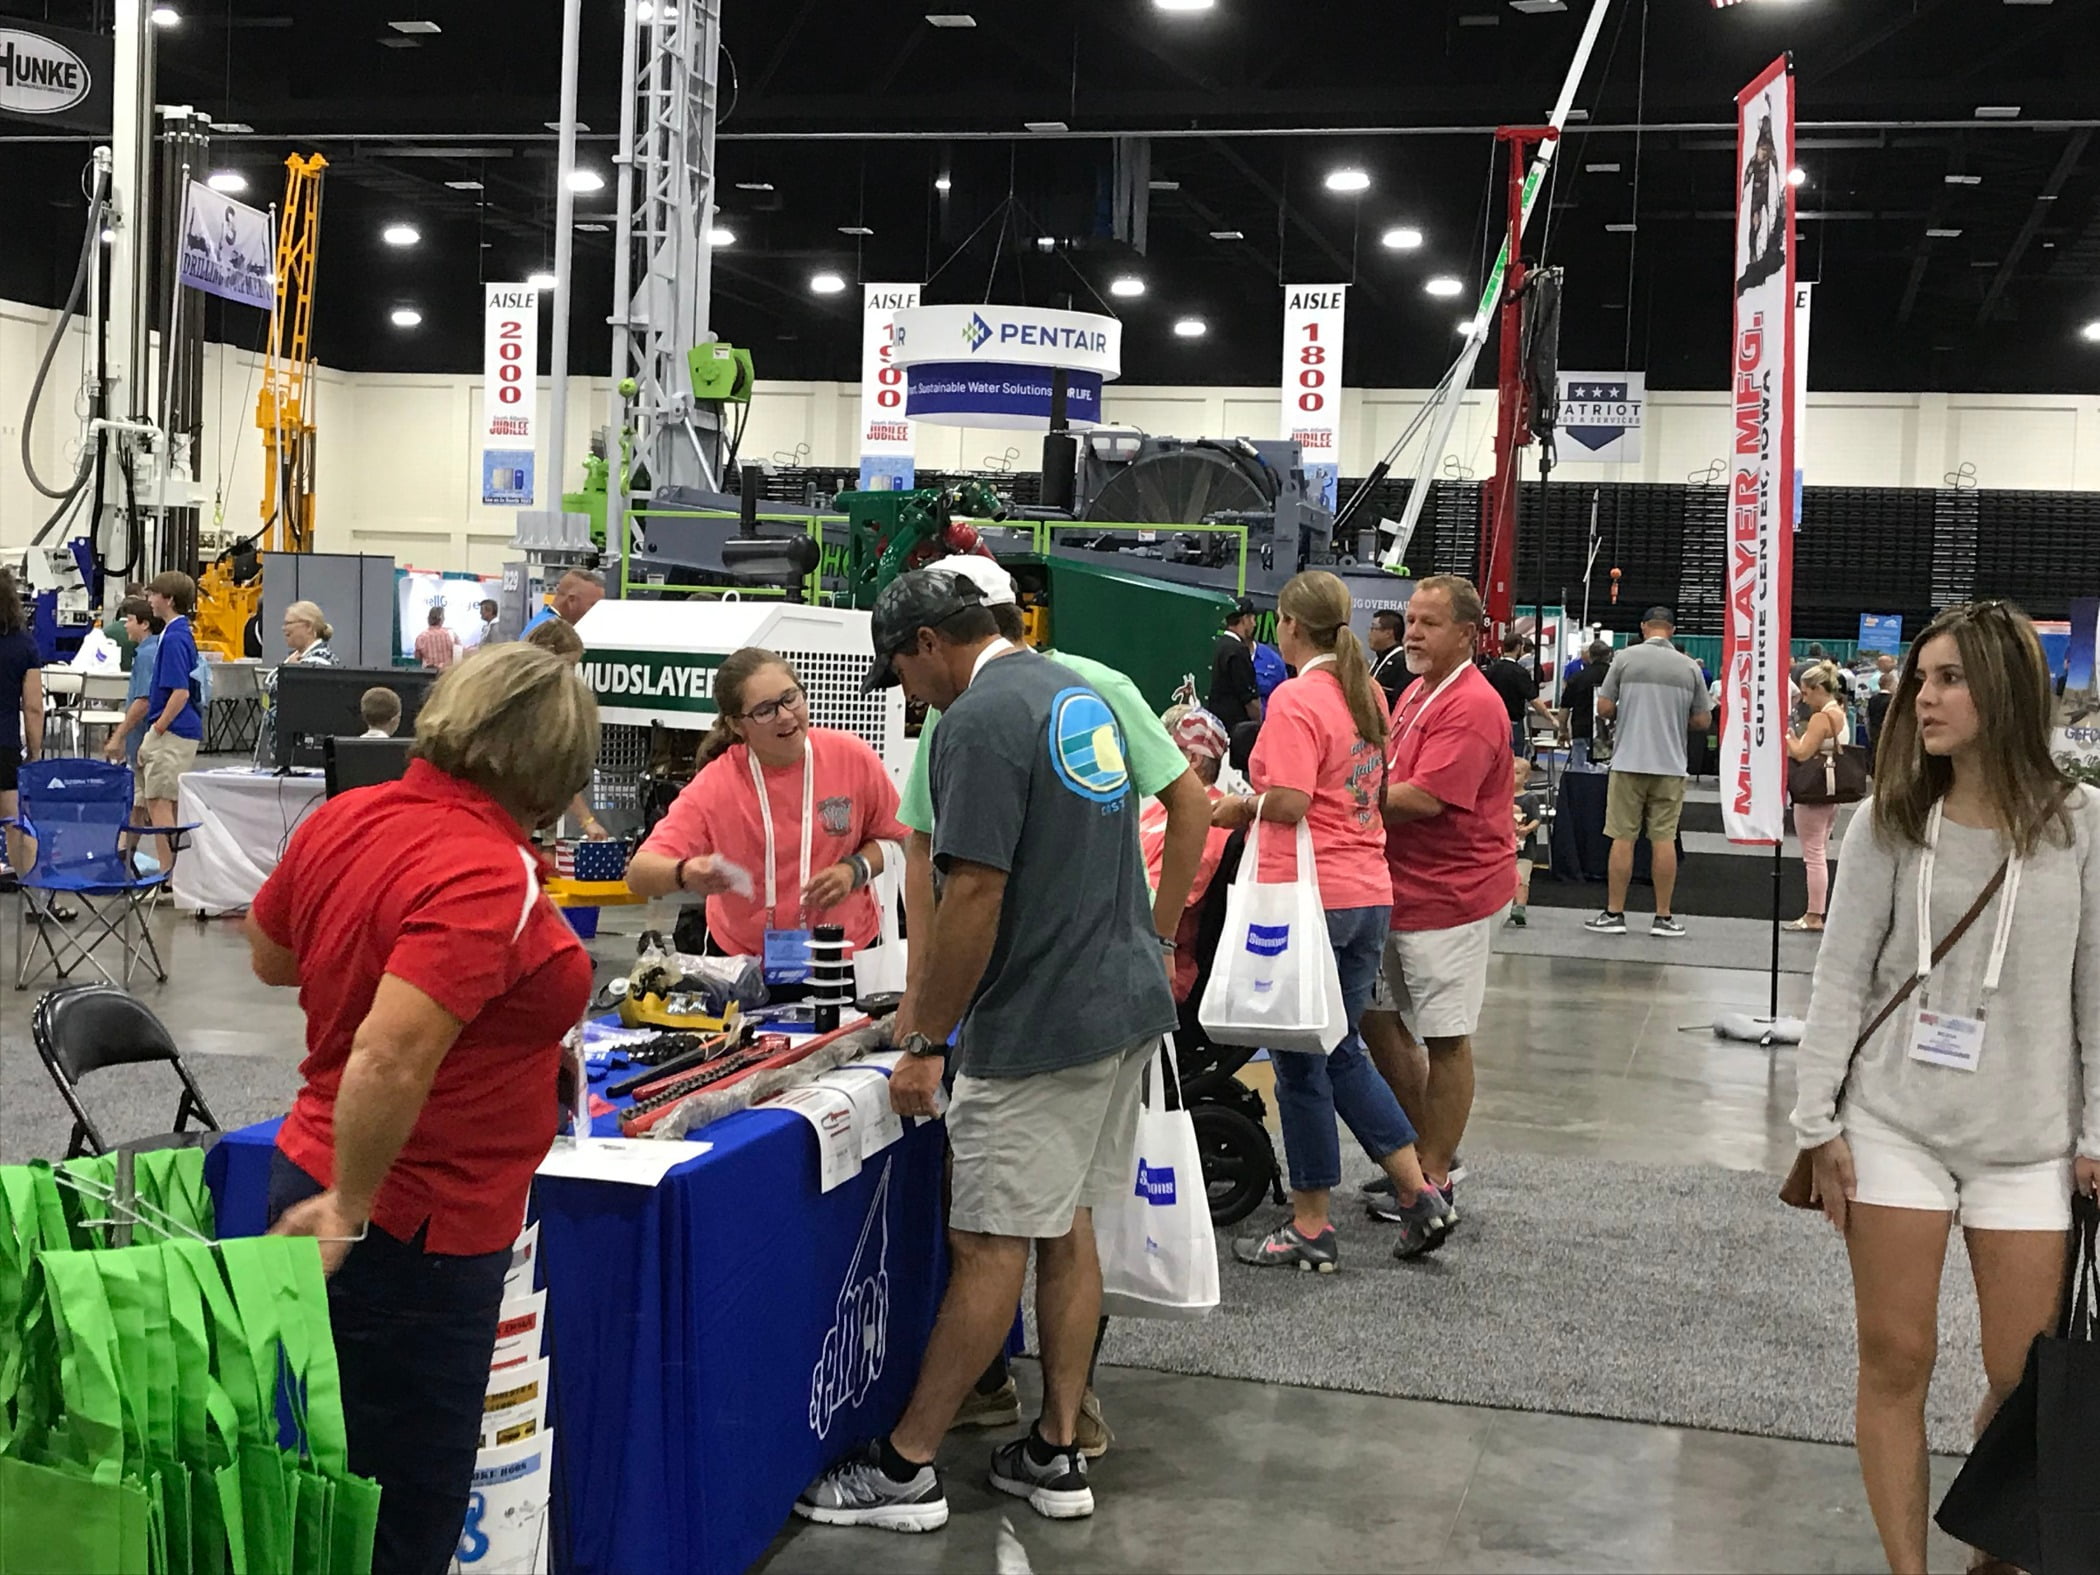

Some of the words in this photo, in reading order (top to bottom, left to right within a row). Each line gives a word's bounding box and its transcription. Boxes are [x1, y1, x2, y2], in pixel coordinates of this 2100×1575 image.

[489, 292, 535, 308] AISLE
[868, 293, 917, 310] AISLE
[1289, 292, 1342, 310] AISLE
[1001, 323, 1107, 354] PENTAIR
[499, 321, 522, 404] 2000
[1298, 322, 1326, 412] 1800
[919, 382, 966, 395] Sustainable
[967, 381, 1000, 394] Water
[1002, 383, 1053, 397] Solutions
[1736, 311, 1764, 454] MFG.
[1564, 403, 1641, 416] ATRIOT
[1760, 369, 1771, 460] IOWA
[489, 420, 529, 436] JUBILEE
[1590, 416, 1640, 424] SERVICES
[866, 425, 908, 441] JUBILEE
[1364, 598, 1410, 611] OVERHAU
[1734, 468, 1760, 815] MUDSLAYER
[1755, 607, 1767, 748] GUTHRIE
[2065, 726, 2100, 741] GEFC
